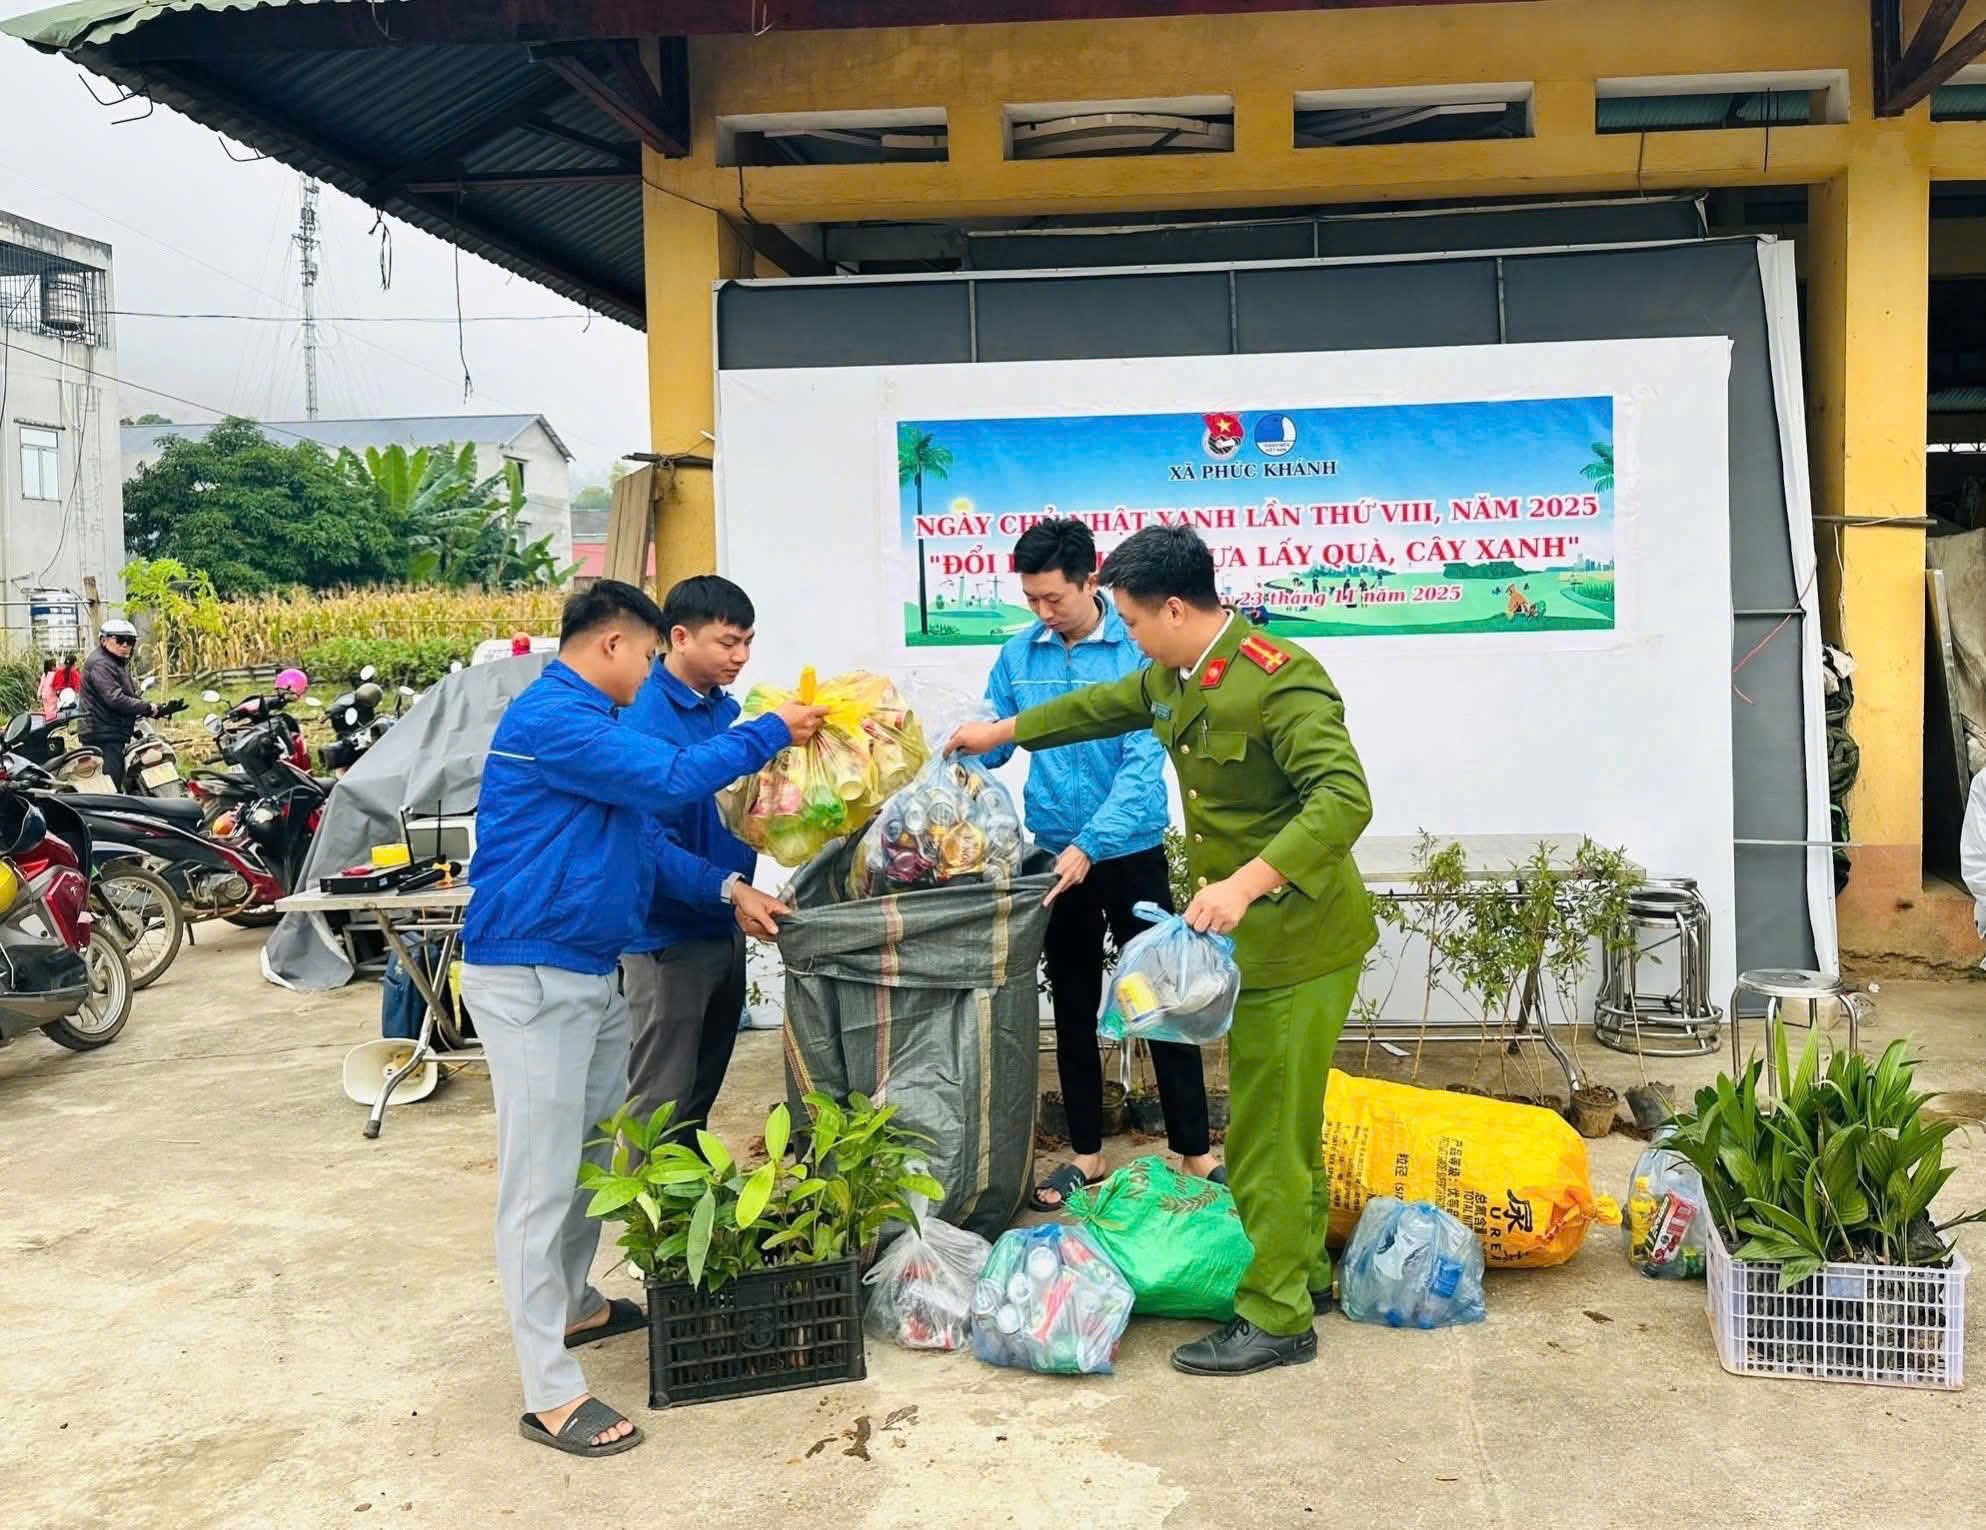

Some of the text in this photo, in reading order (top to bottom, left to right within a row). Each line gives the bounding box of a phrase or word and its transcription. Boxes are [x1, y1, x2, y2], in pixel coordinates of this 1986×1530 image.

[1171, 457, 1336, 480] XÃ PHÚC KHÁNH
[916, 511, 991, 536] NGÀY
[999, 507, 1060, 535] CH
[1156, 509, 1235, 528] XANH
[1246, 499, 1301, 527] LẦN
[1311, 500, 1377, 525] THỨ
[1380, 502, 1440, 525] VIII,
[1452, 495, 1519, 521] NĂM
[1529, 496, 1597, 518] 2025
[930, 544, 996, 575] "ĐỔI
[1258, 537, 1313, 567] LẤY
[1322, 537, 1395, 568] QUÀ,
[1406, 535, 1466, 563] CÂY
[1476, 536, 1579, 560] XANH"
[1269, 590, 1326, 607] tháng
[1363, 588, 1405, 603] năm
[1412, 586, 1461, 601] 2025
[1463, 1190, 1475, 1213] TOTAL
